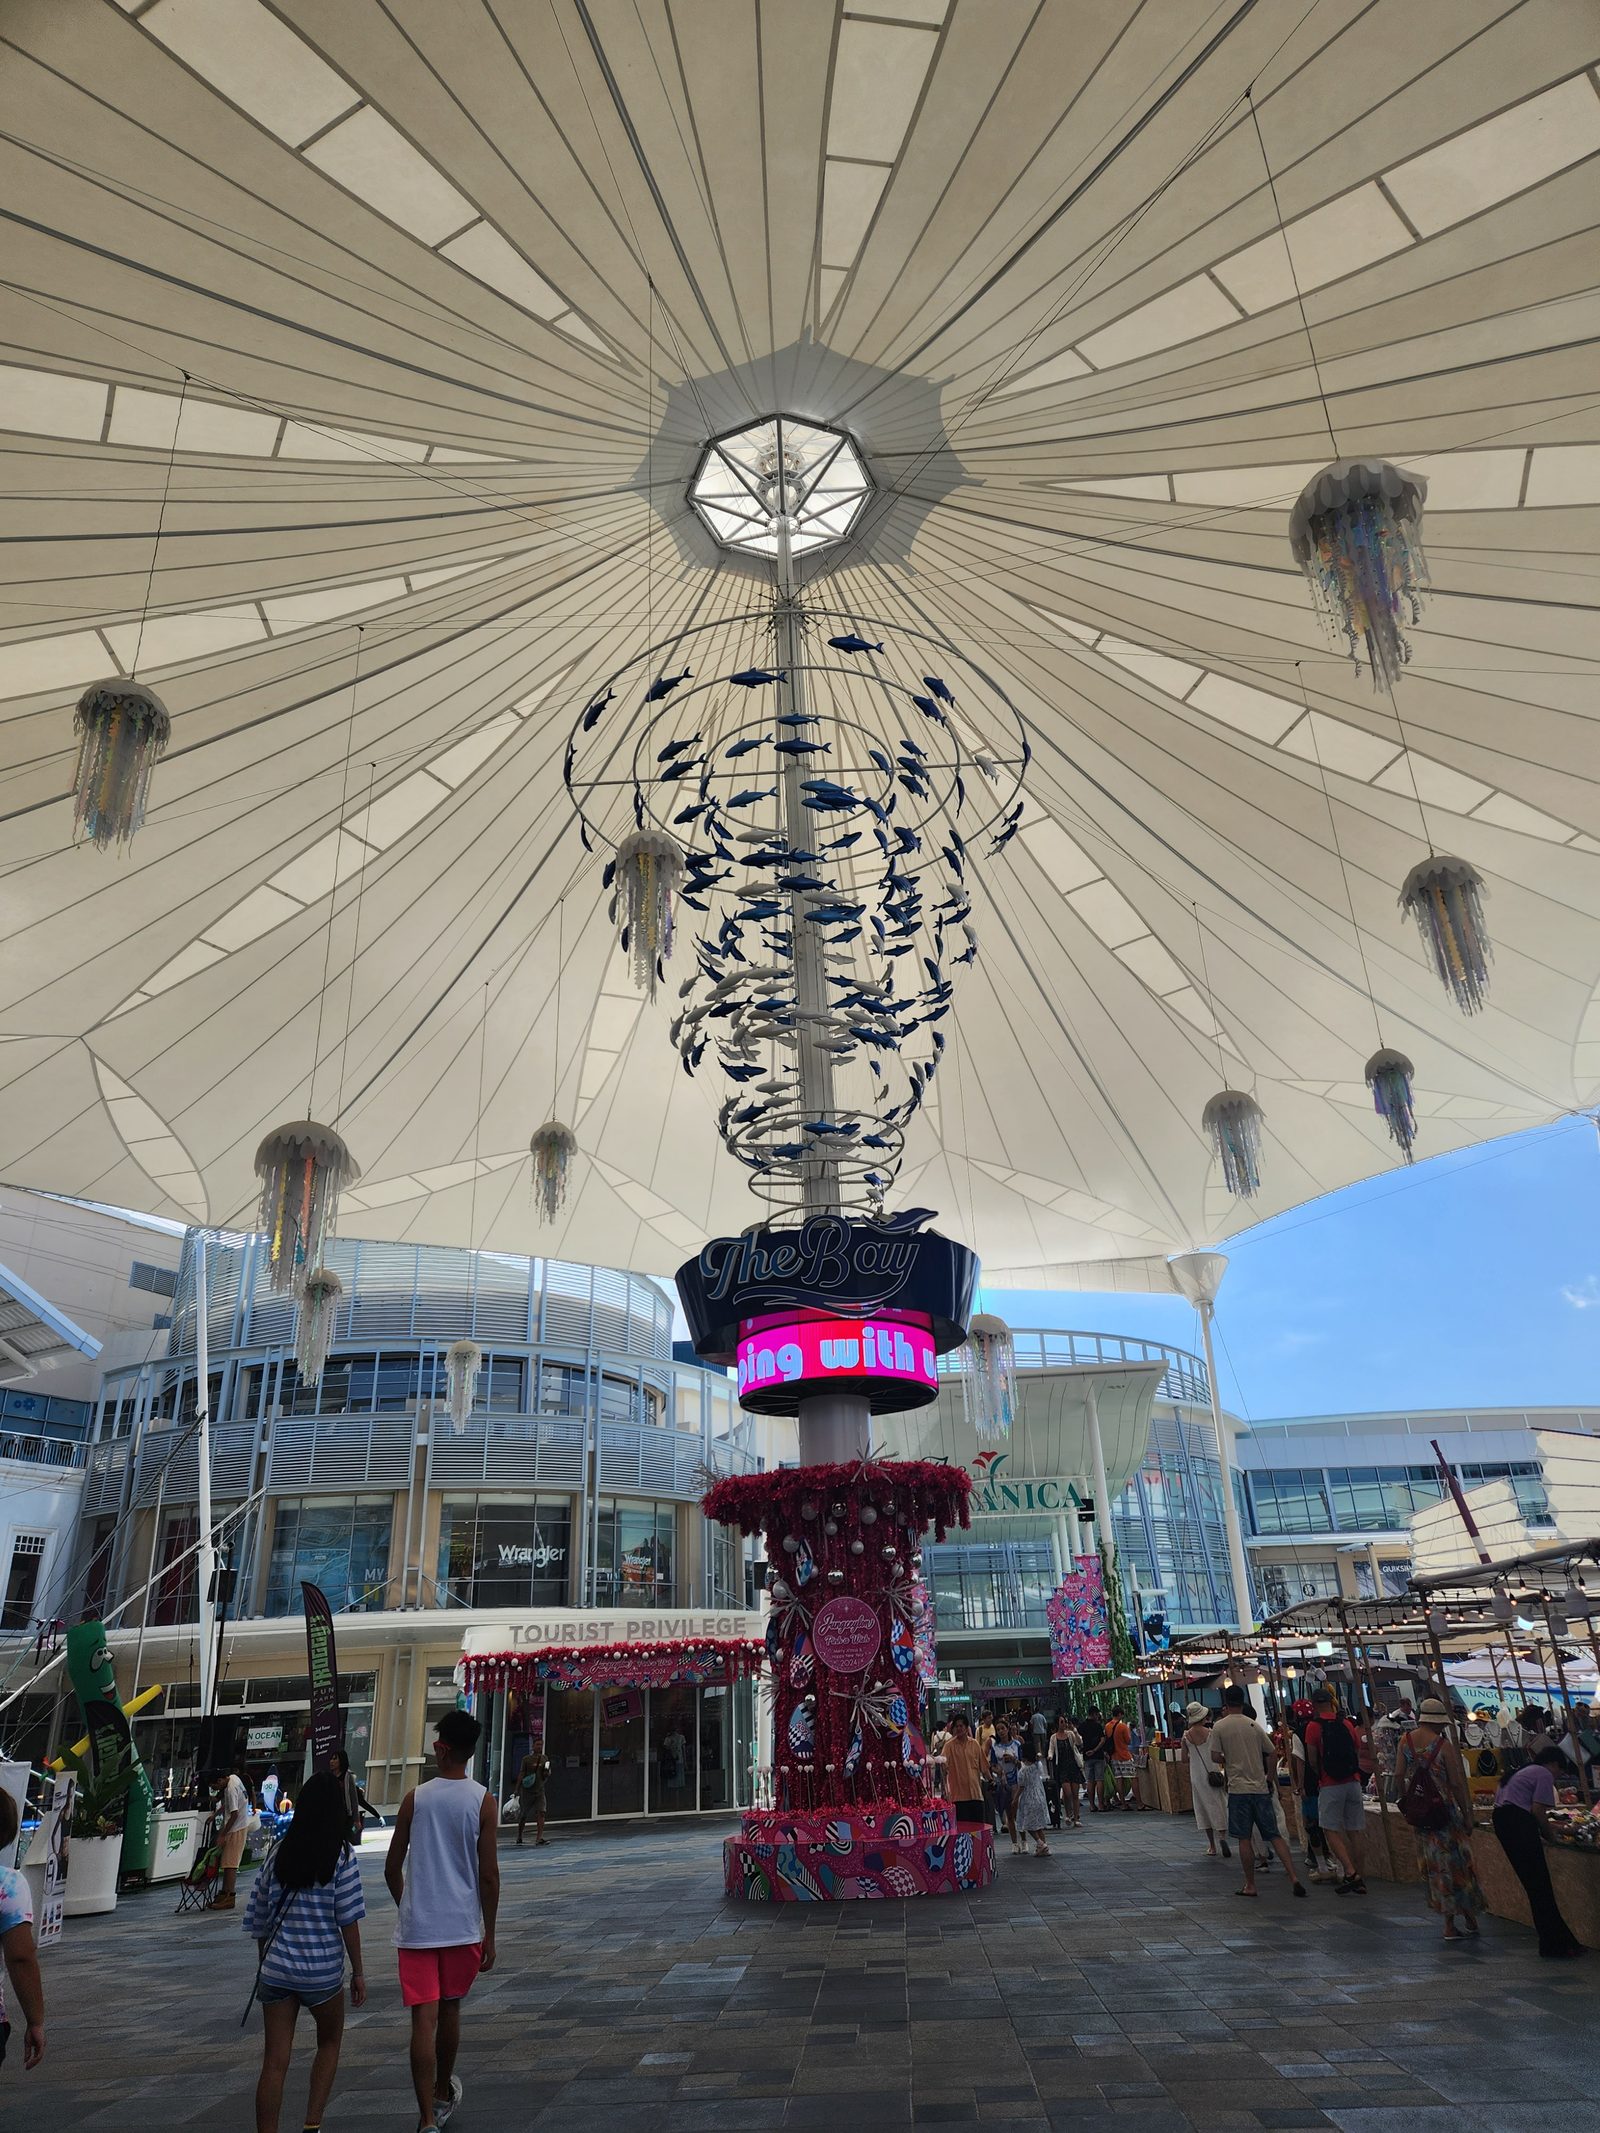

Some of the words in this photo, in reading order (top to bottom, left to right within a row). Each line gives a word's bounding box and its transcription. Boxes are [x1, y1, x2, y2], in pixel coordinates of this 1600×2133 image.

[700, 1231, 804, 1300] The
[799, 1213, 921, 1300] Bay
[820, 1326, 915, 1374] with
[923, 1347, 937, 1382] u
[498, 1544, 566, 1569] Wrangler
[624, 1553, 652, 1568] Wrangler
[509, 1622, 614, 1644] TOURIST
[627, 1617, 747, 1641] PRIVILEGE
[818, 1612, 876, 1636] Jungceylon
[840, 1659, 858, 1667] 2024
[313, 1687, 335, 1697] FUN
[313, 1695, 335, 1703] PARK
[255, 1731, 281, 1739] OCEAN
